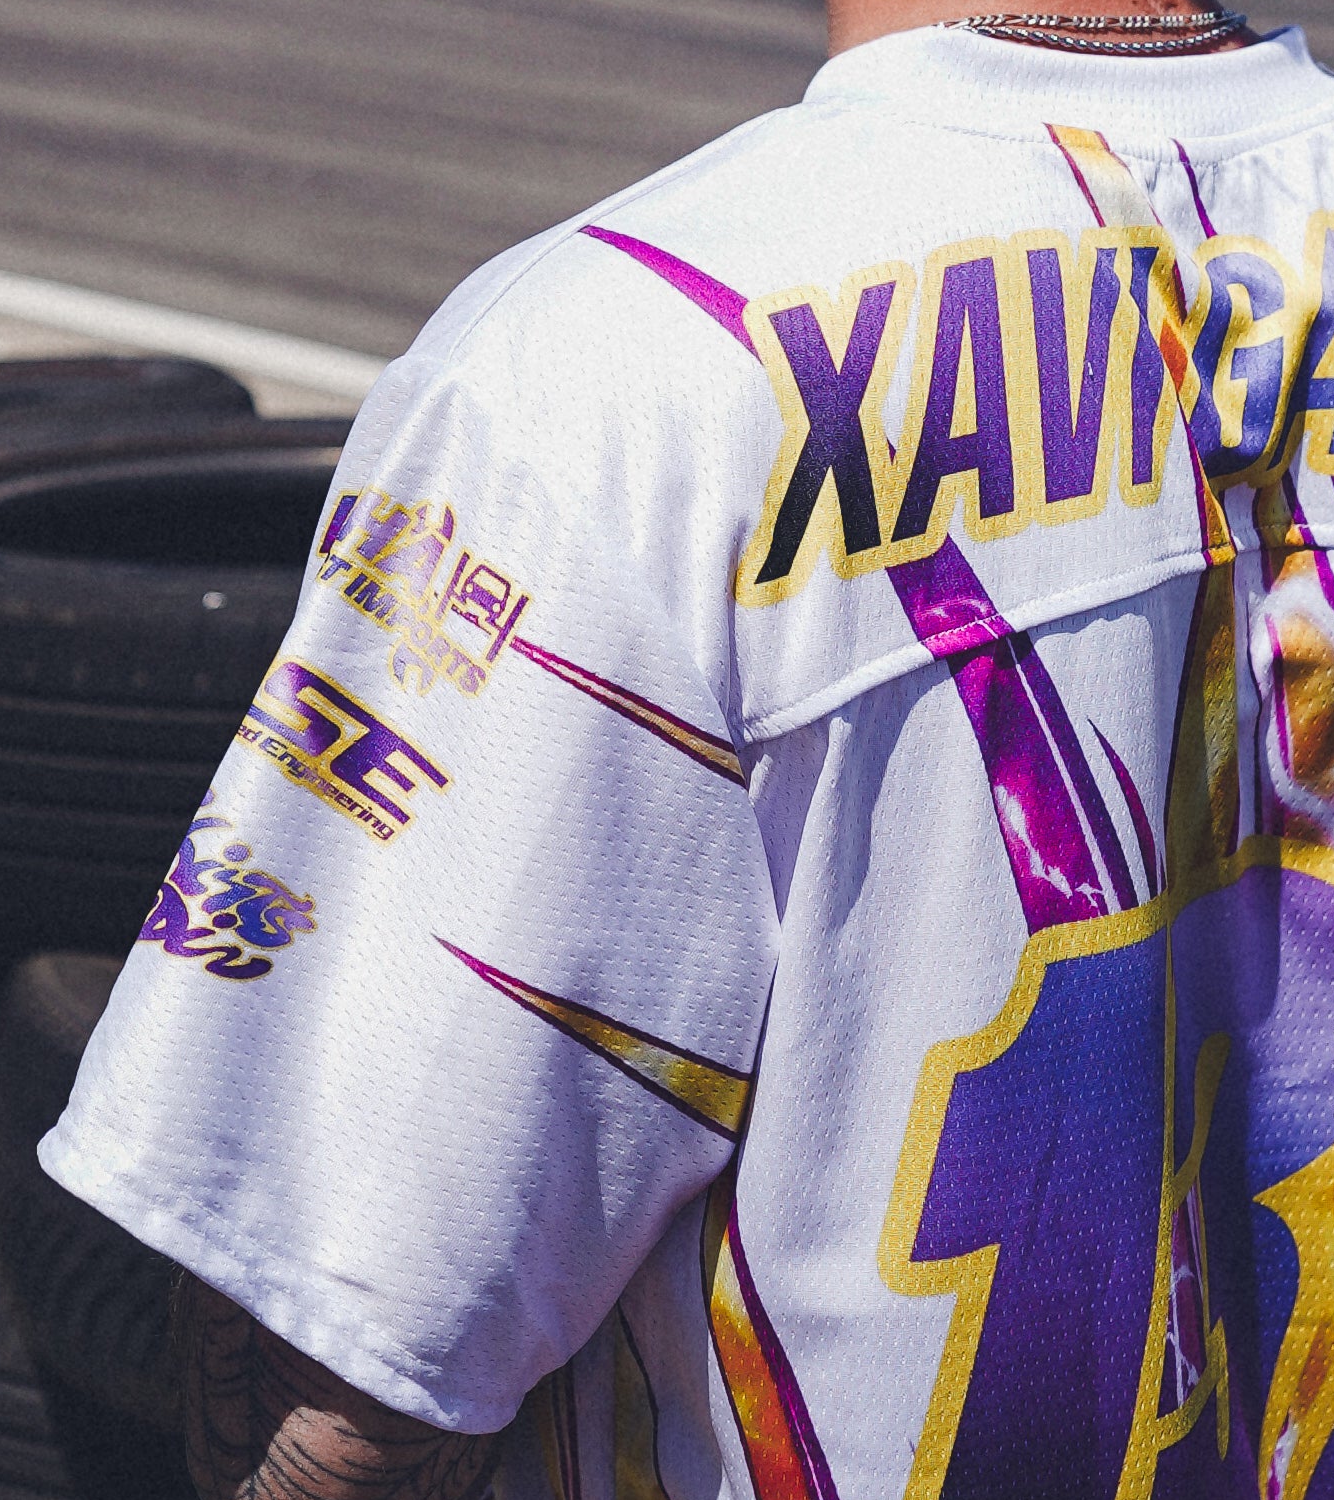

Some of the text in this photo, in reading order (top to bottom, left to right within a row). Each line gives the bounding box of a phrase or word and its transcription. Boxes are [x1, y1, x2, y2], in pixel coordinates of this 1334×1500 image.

[741, 230, 1171, 602] XAVI
[343, 572, 488, 694] IMPORTS
[259, 734, 396, 841] Engineering
